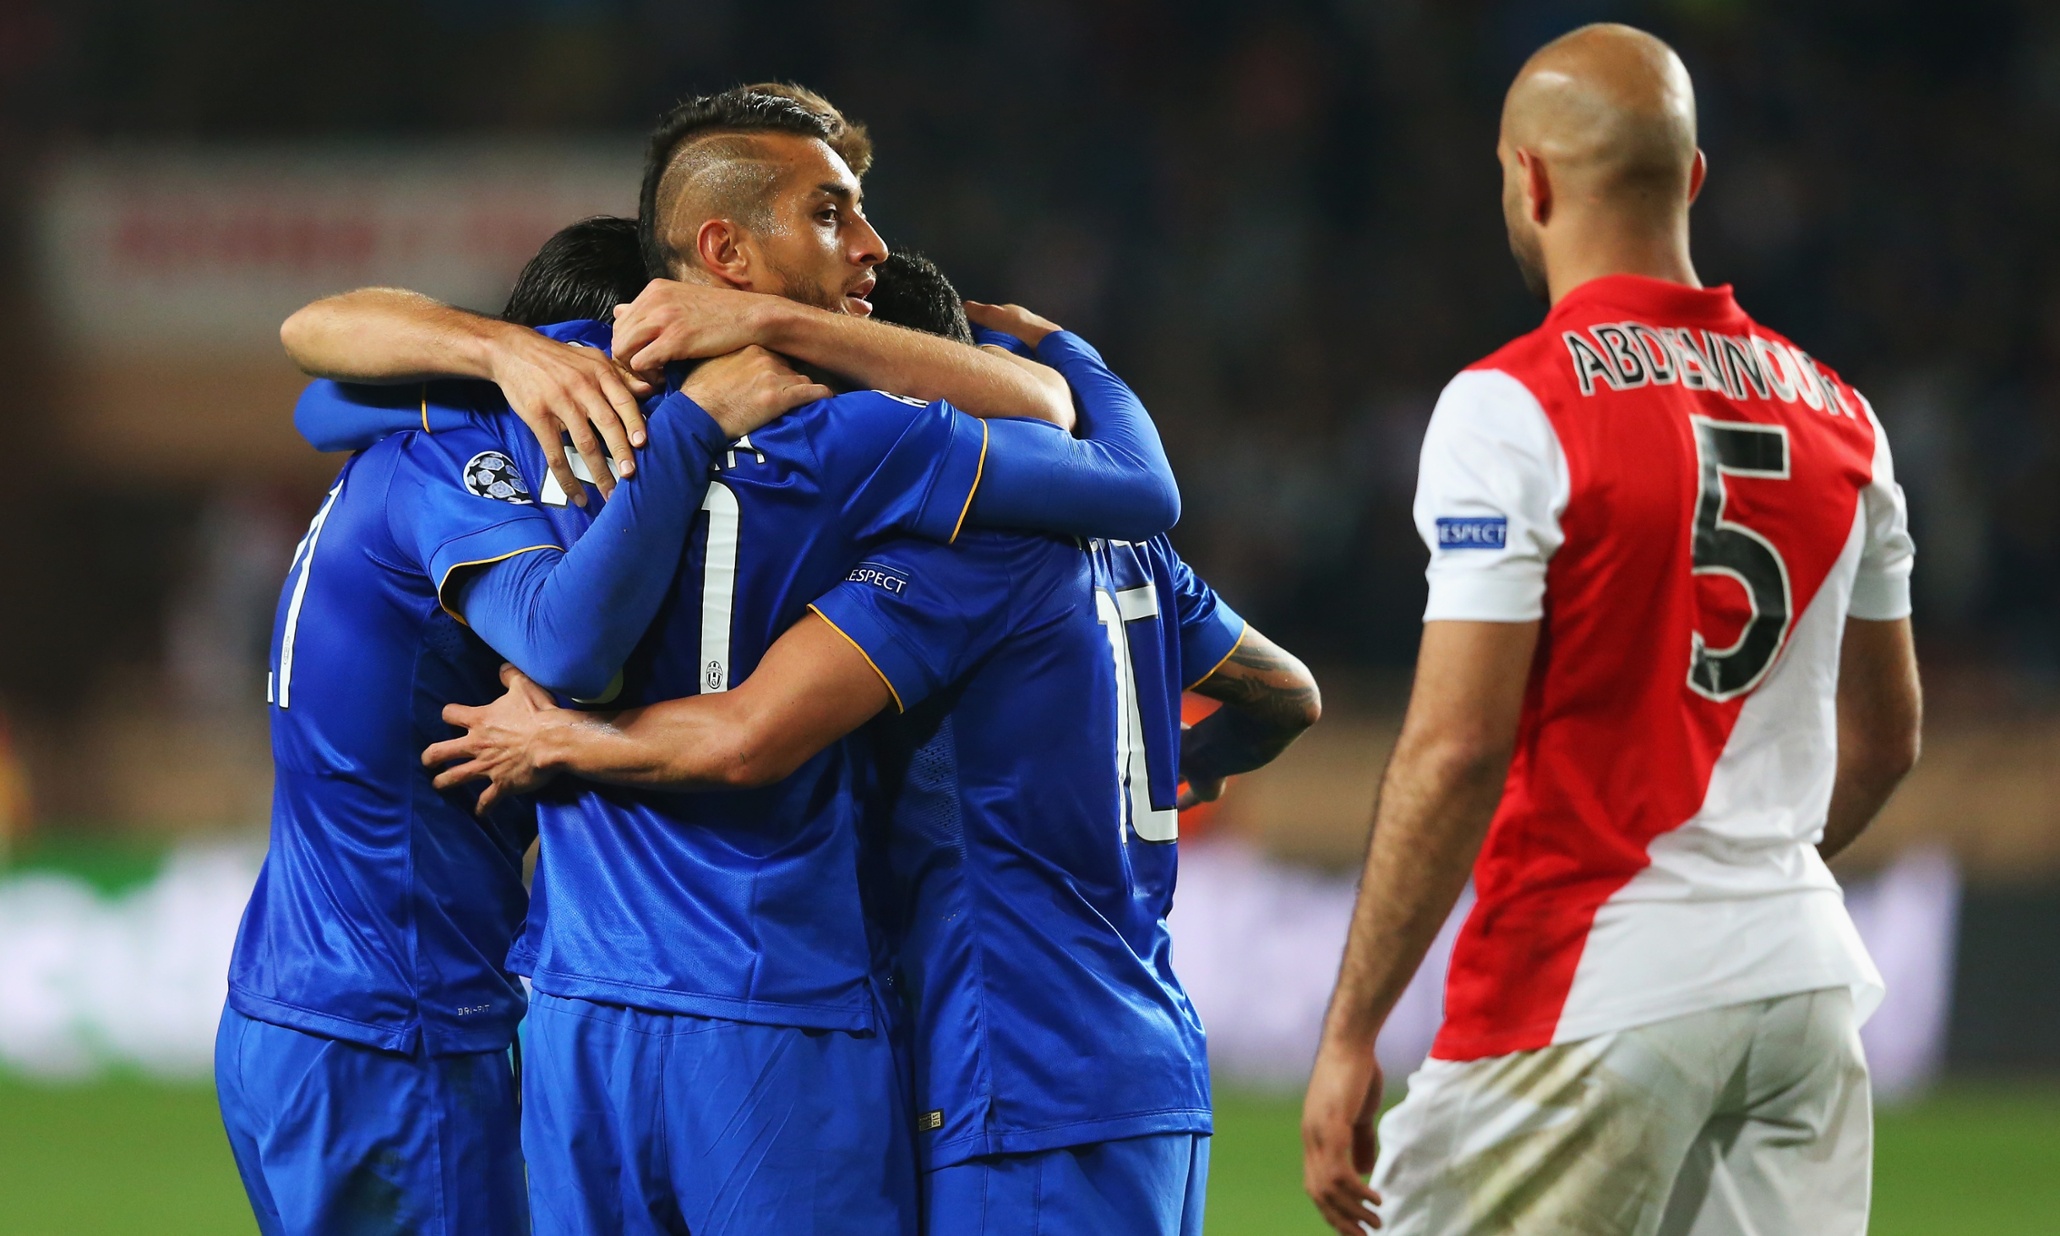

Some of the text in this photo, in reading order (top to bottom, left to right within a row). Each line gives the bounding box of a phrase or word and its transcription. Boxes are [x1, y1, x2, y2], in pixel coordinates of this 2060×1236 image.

[1562, 320, 1855, 420] ABDENNOUR
[1438, 523, 1506, 544] ESPECT
[1686, 412, 1792, 703] 5
[845, 569, 907, 594] ESPECT
